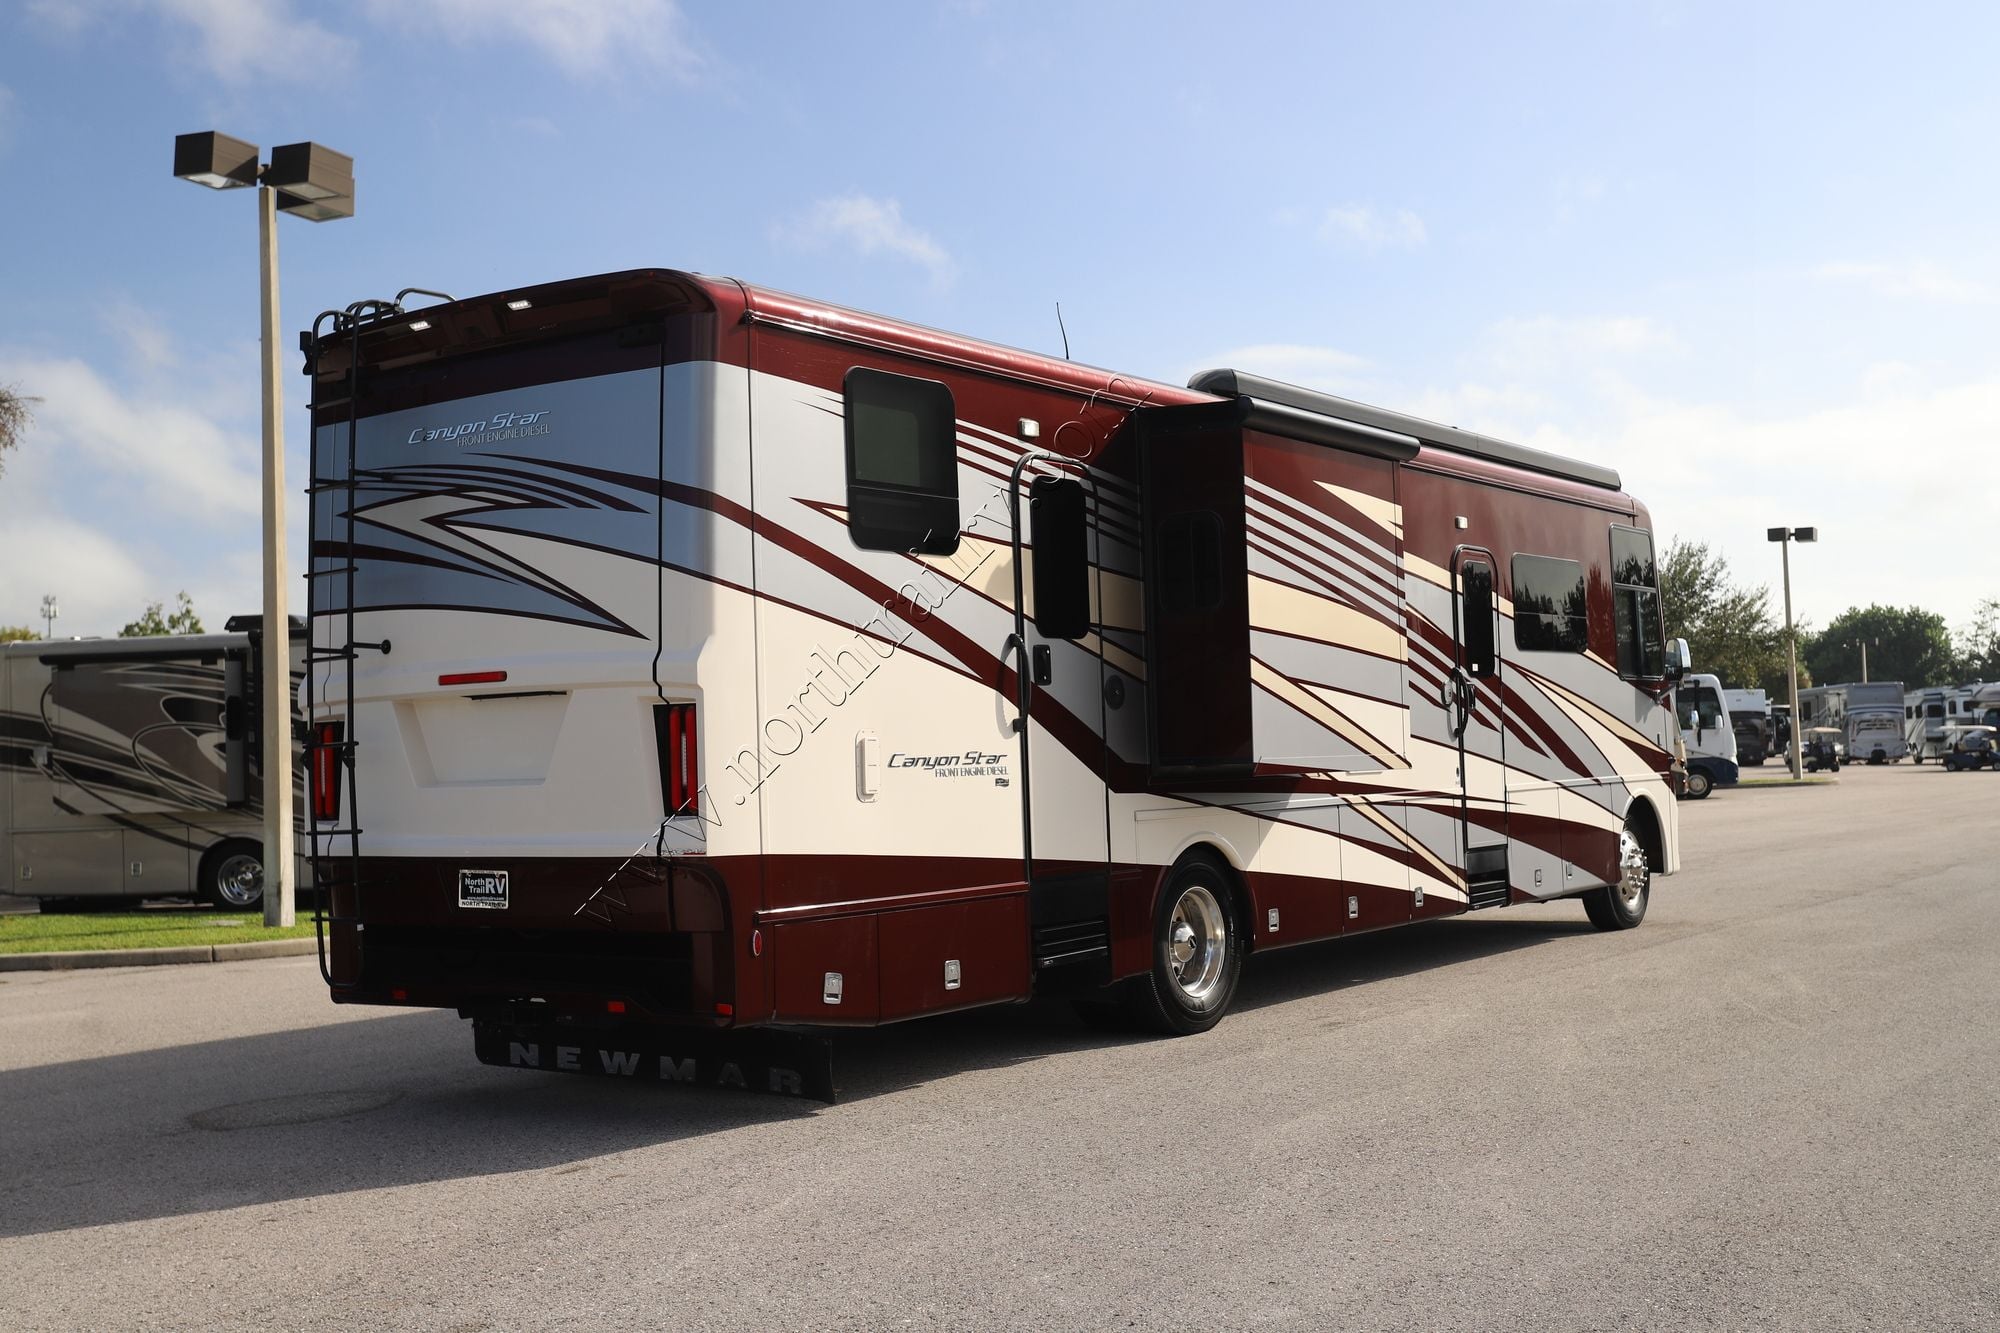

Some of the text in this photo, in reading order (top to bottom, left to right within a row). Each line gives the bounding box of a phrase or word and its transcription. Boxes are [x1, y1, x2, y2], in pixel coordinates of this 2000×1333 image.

[408, 411, 551, 444] Canyon Star
[457, 424, 550, 447] FRONT ENGINE DIESEL
[888, 751, 1008, 770] Canyon Star
[935, 766, 1008, 777] FRONT ENGINE DIESEL
[465, 878, 485, 886] North
[485, 878, 505, 894] RV
[509, 1042, 802, 1095] NEWMAR
